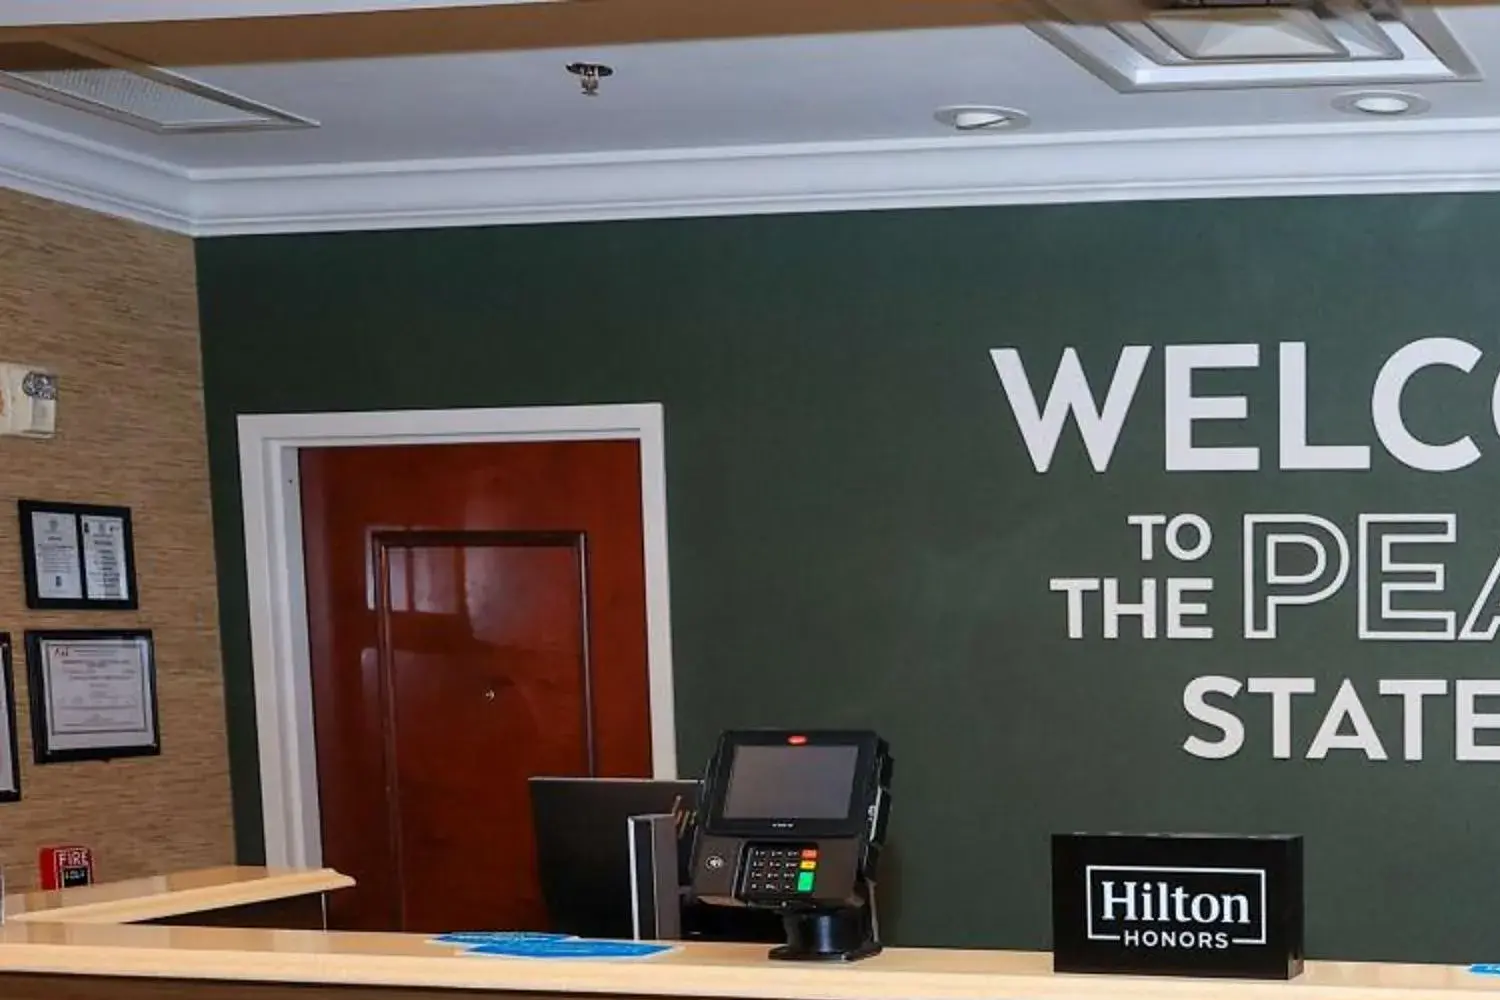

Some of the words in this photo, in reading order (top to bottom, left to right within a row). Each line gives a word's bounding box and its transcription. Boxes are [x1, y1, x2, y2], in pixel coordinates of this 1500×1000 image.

[1127, 513, 1213, 561] TO
[1049, 577, 1214, 640] THE
[58, 851, 89, 866] FIRE
[1100, 880, 1251, 924] Hilton
[1123, 929, 1229, 949] HONORS
